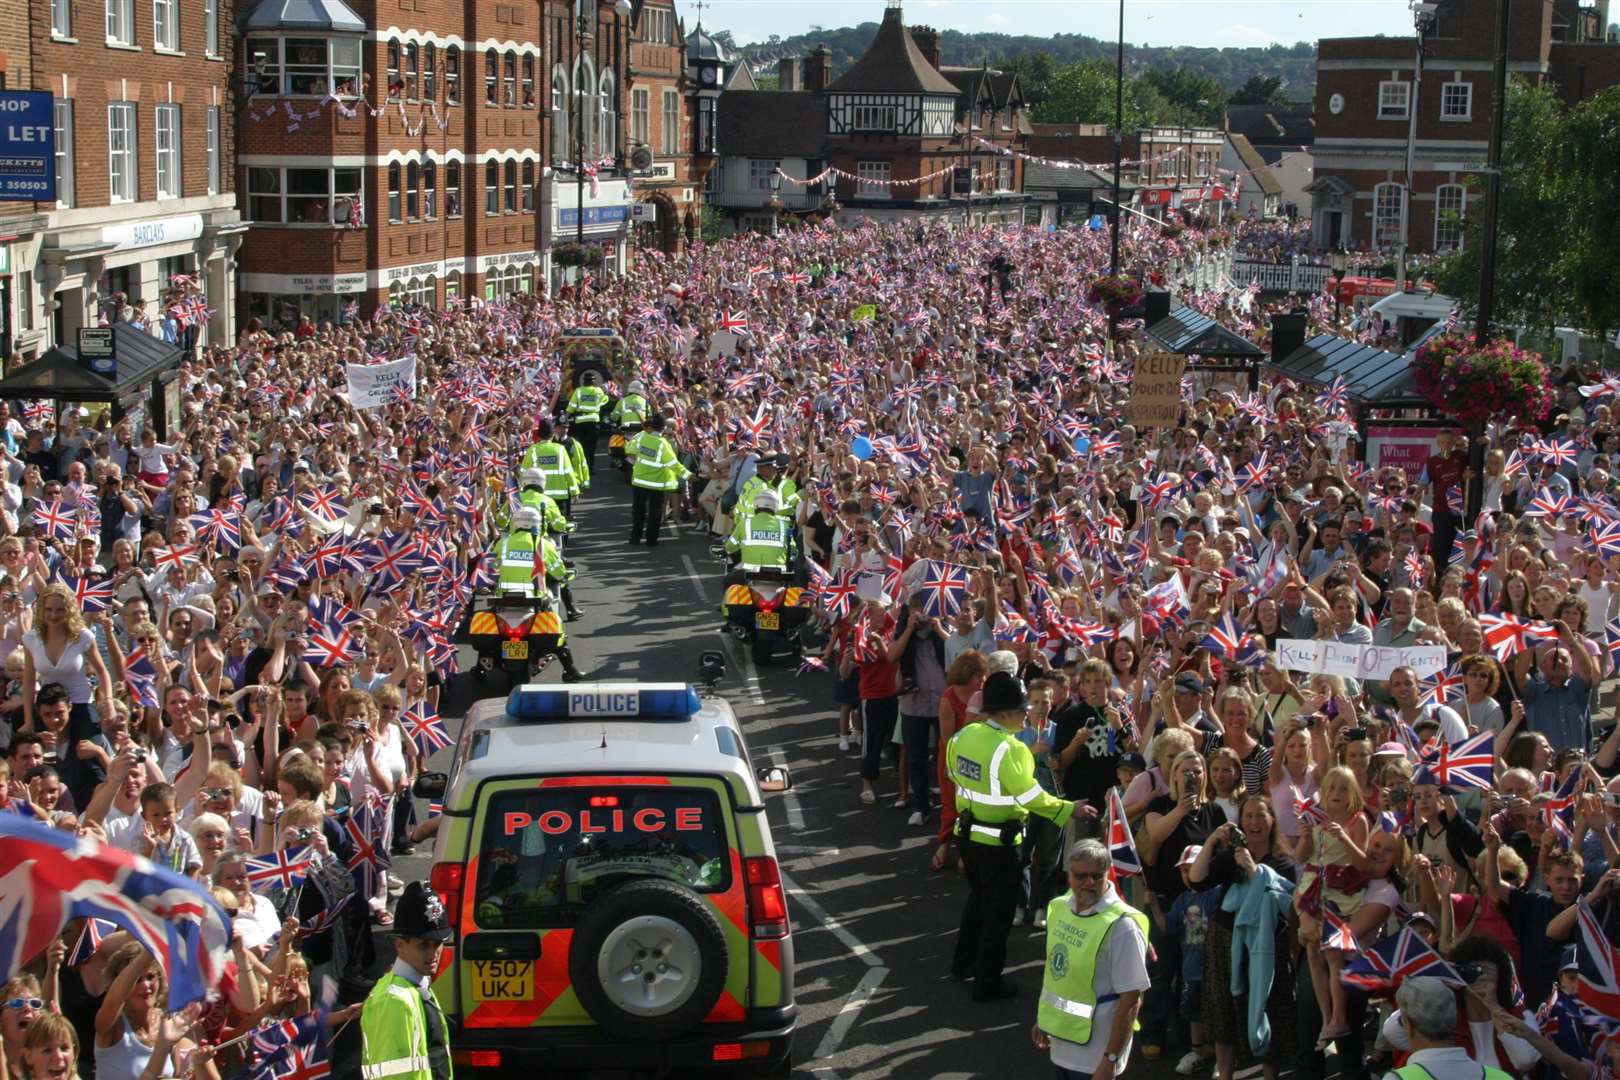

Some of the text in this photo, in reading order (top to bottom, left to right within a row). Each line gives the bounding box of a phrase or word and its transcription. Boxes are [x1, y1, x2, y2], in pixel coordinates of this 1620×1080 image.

[8, 126, 50, 142] LET
[7, 181, 48, 190] 350503
[134, 223, 166, 245] BARCLAYS
[1138, 356, 1181, 375] KELLY
[375, 372, 401, 382] KELLY
[1382, 445, 1410, 458] What
[752, 531, 780, 540] POLICE
[509, 550, 534, 560] POLICE
[1362, 648, 1393, 673] OF
[571, 694, 636, 712] POLICE
[957, 757, 980, 779] POLICE
[504, 808, 703, 835] POLICE
[474, 960, 532, 978] Y507
[482, 981, 525, 998] UKJ
